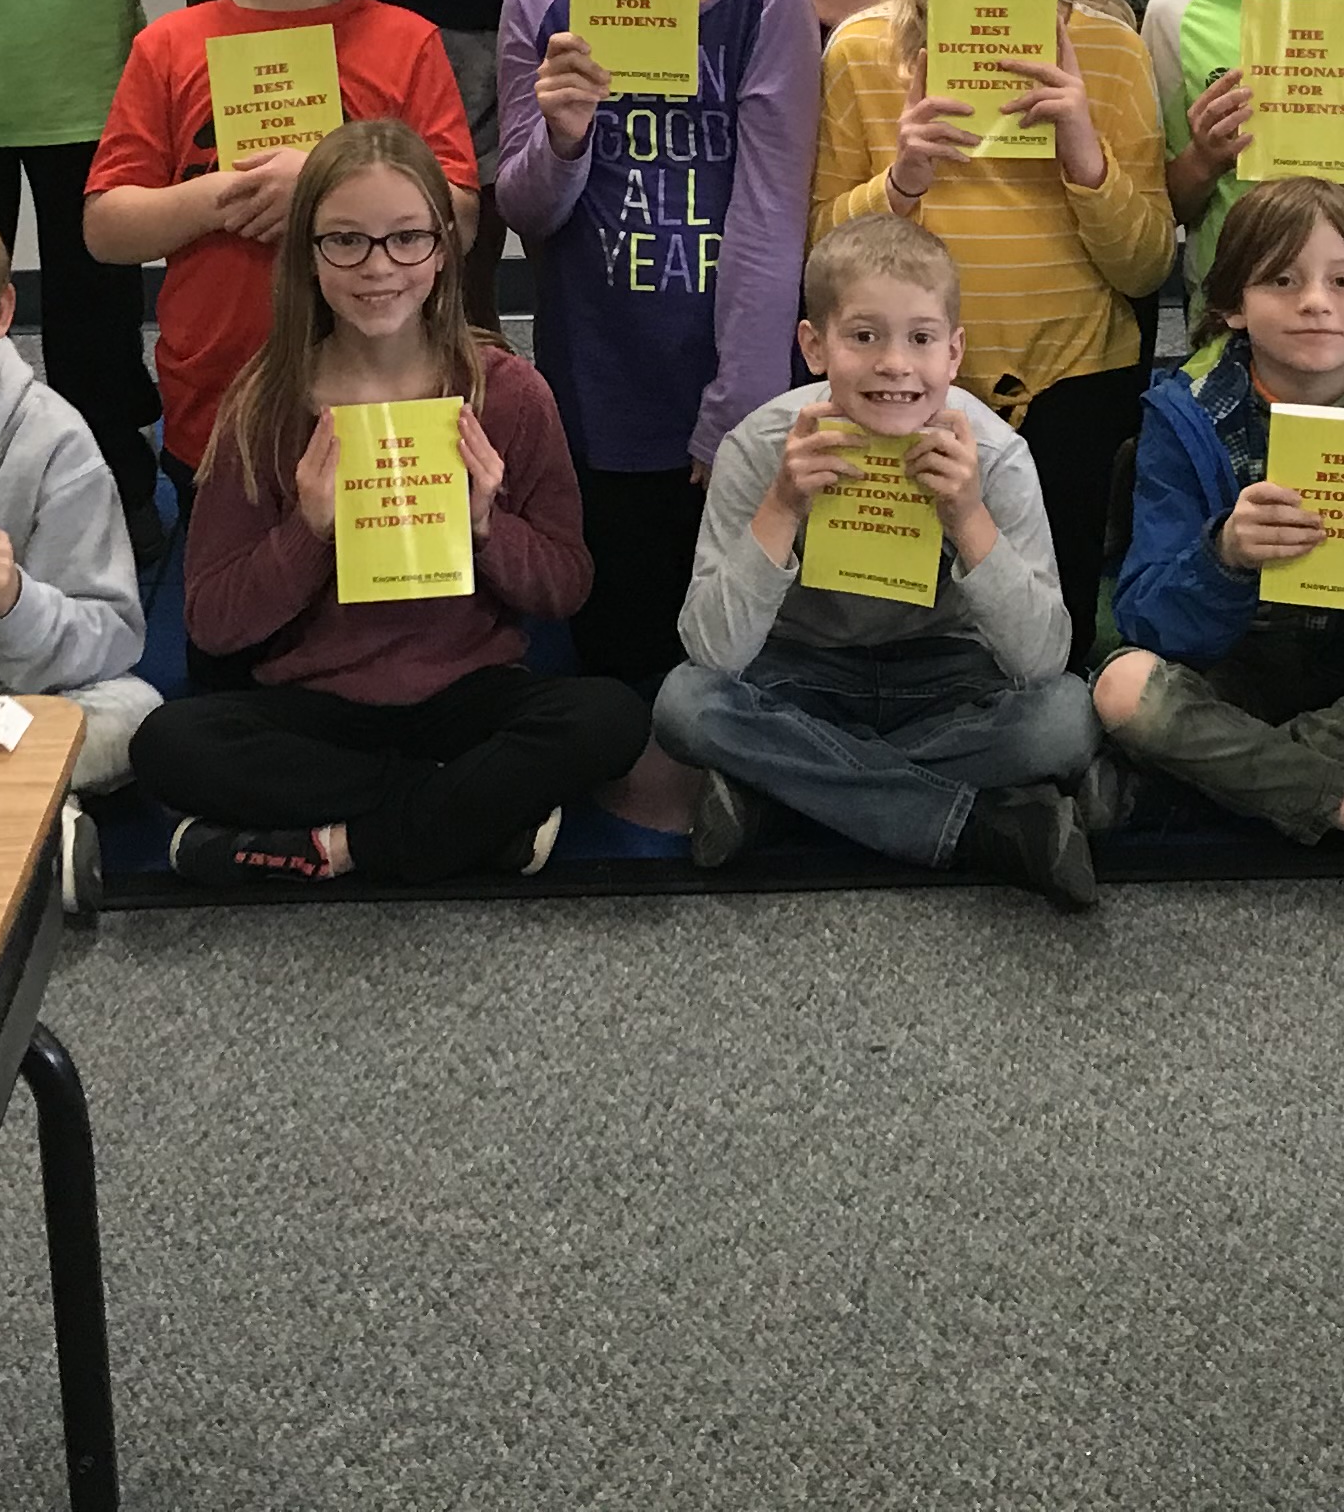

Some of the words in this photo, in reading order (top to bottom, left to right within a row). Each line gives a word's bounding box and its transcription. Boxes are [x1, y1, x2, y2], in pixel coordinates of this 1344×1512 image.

[589, 15, 677, 28] STUDENTS
[1289, 29, 1324, 41] THE
[1285, 47, 1328, 59] BEST
[1287, 84, 1322, 97] FOR
[596, 109, 732, 162] GOOD
[620, 169, 710, 225] ALL
[376, 456, 419, 470] BEST
[344, 472, 454, 491] DICTIONARY
[381, 495, 418, 508] FOR
[354, 512, 446, 530] STUDENTS
